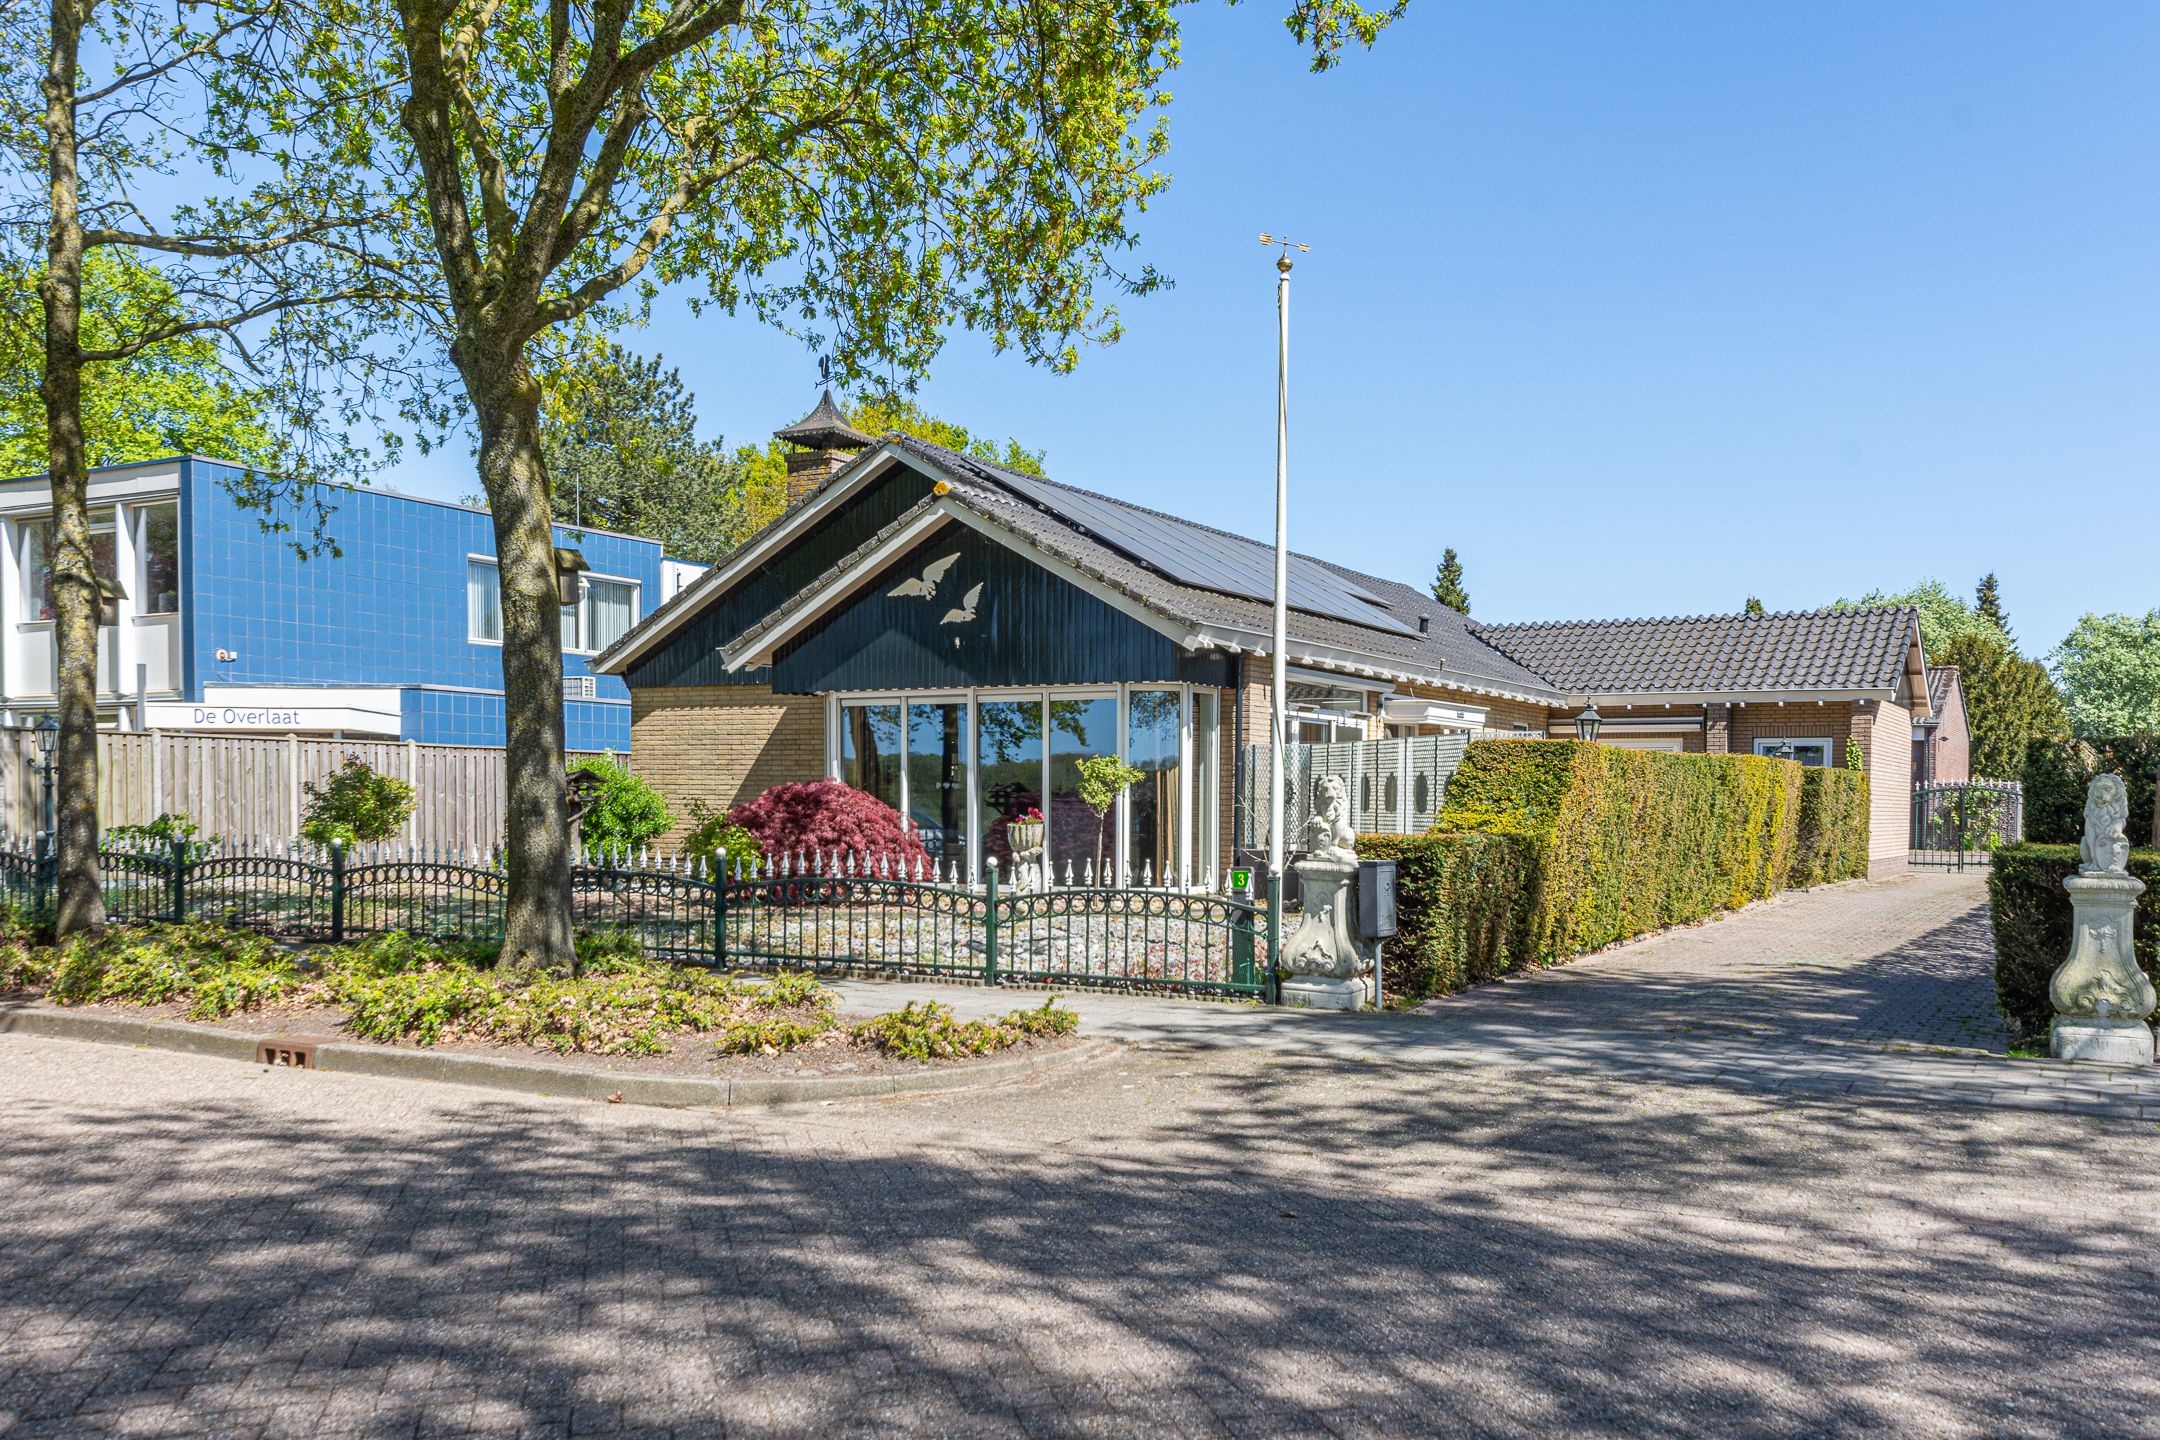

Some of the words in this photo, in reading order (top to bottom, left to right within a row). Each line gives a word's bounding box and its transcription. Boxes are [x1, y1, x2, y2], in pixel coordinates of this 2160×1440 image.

[194, 708, 216, 724] De
[223, 708, 300, 725] Overlaat
[1237, 873, 1245, 886] 3
